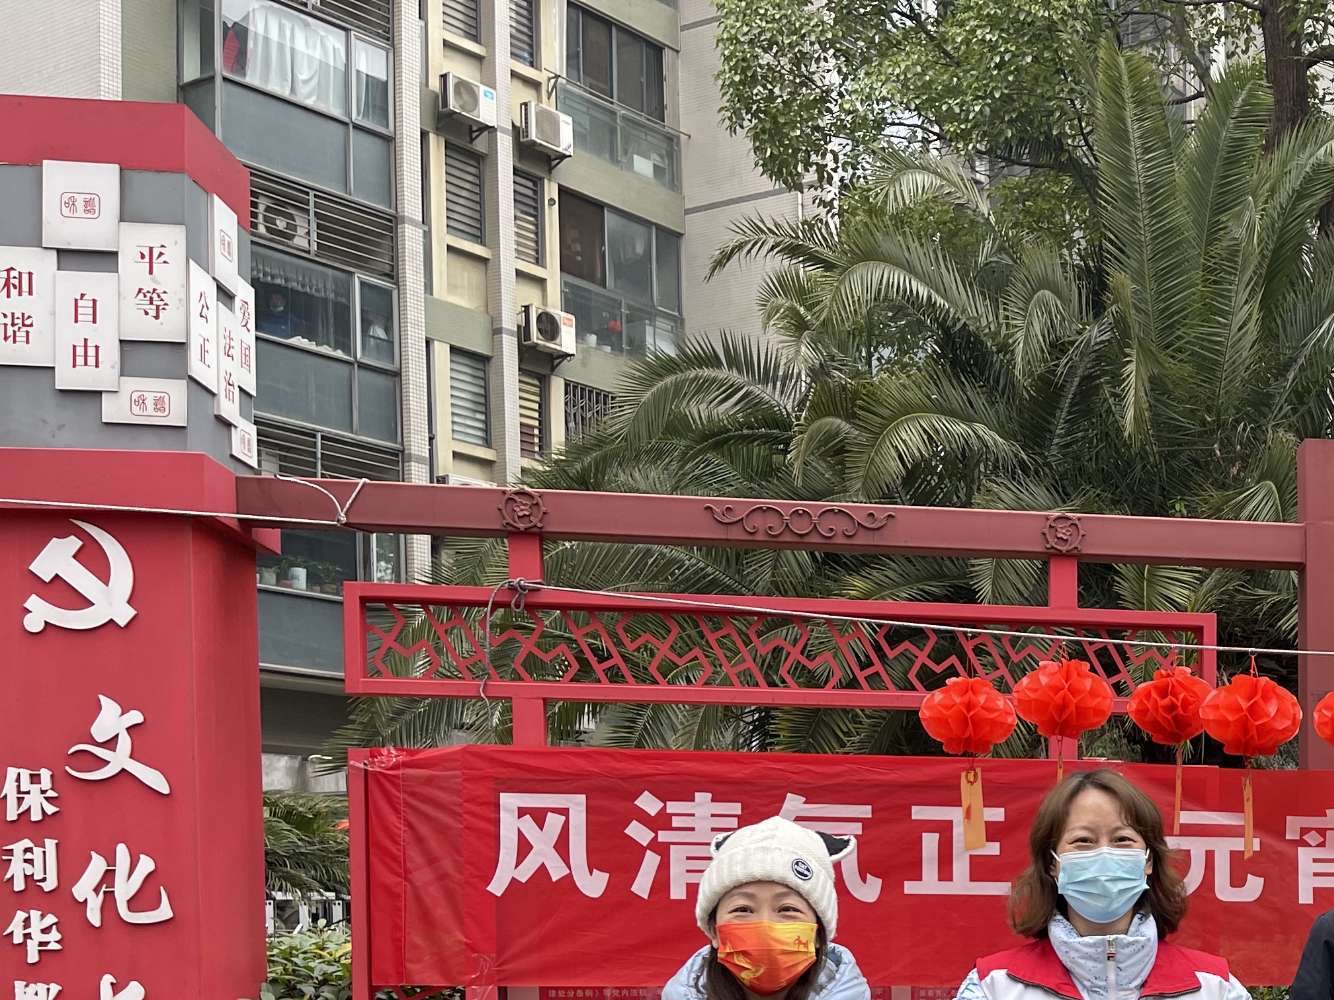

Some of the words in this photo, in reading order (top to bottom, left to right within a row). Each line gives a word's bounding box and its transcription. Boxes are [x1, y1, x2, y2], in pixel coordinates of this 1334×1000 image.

[0, 266, 34, 346] 和谐
[134, 244, 170, 321] 平等
[72, 292, 100, 369] 自由
[198, 290, 212, 370] 公正
[223, 326, 236, 405] 法治
[239, 298, 252, 372] 爱国
